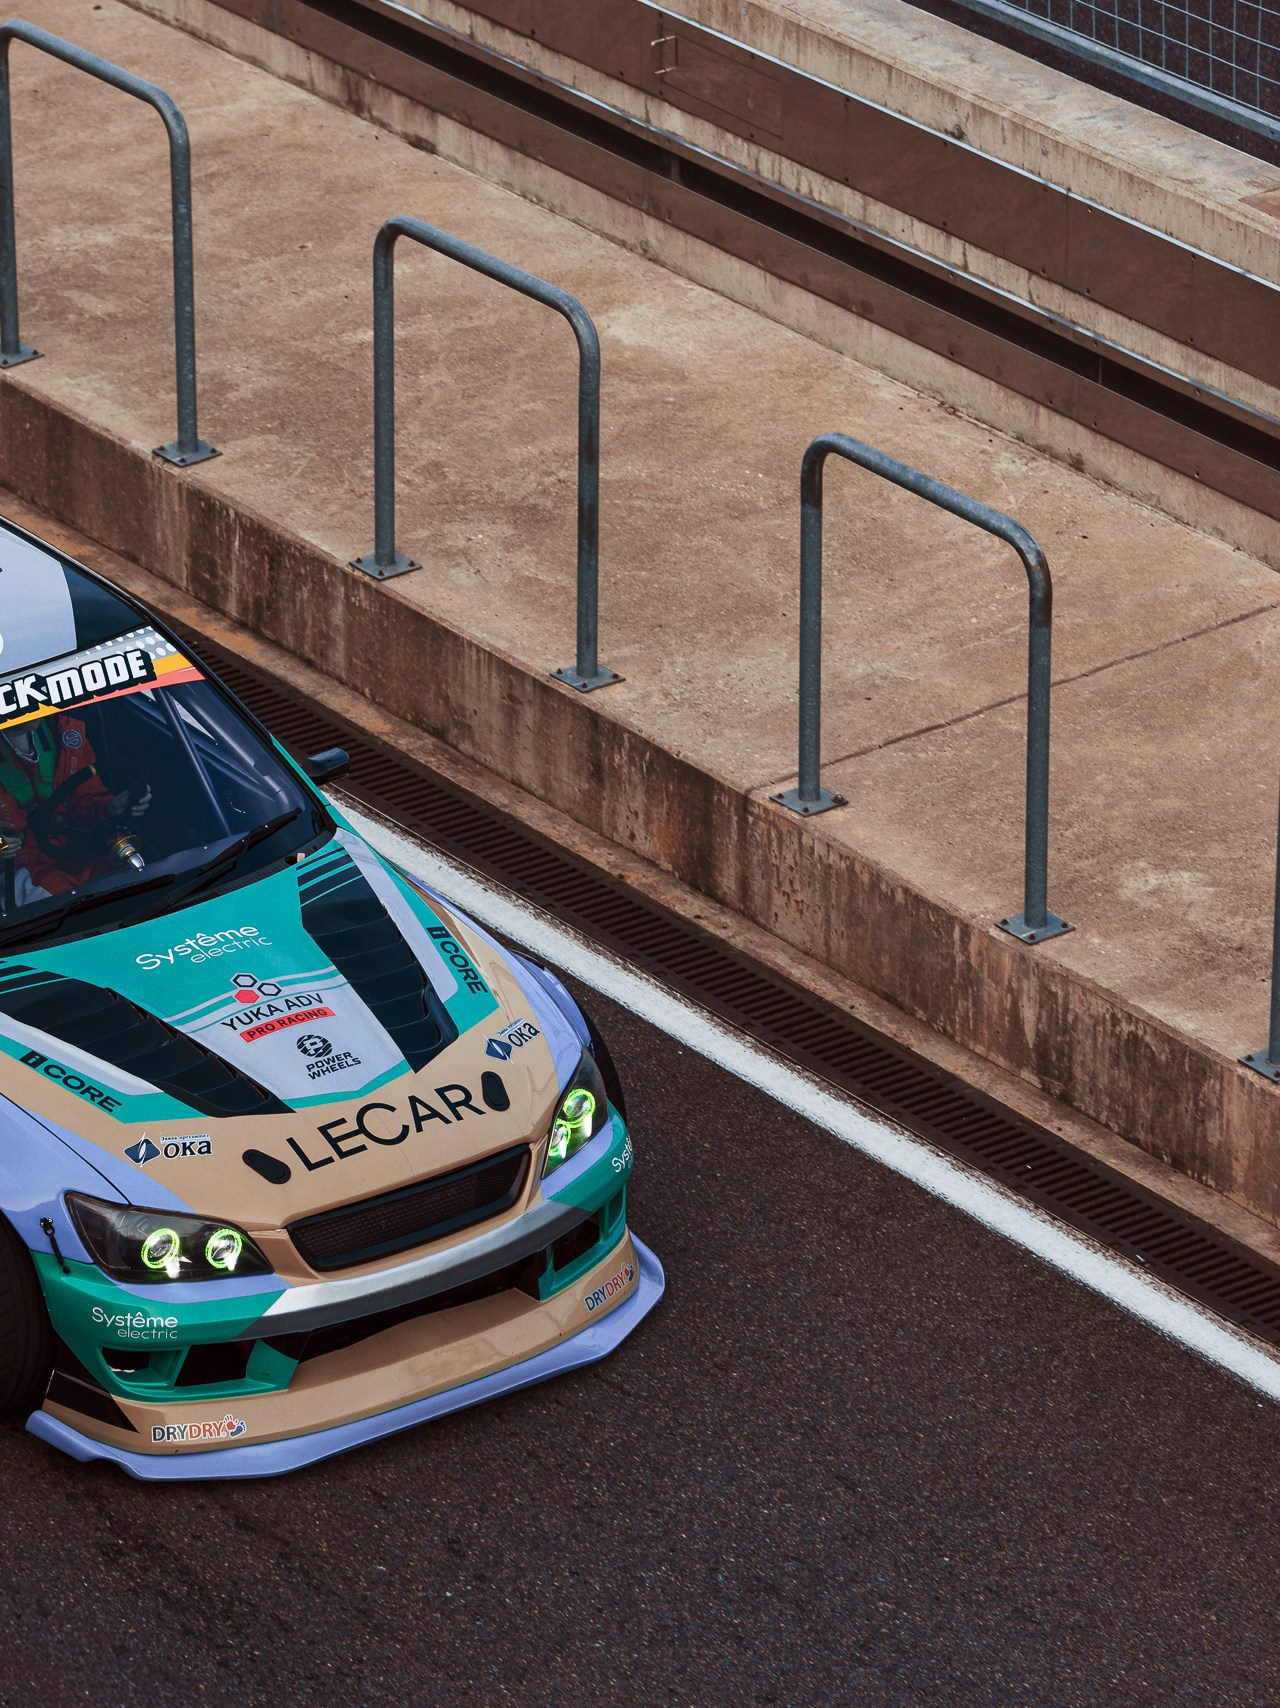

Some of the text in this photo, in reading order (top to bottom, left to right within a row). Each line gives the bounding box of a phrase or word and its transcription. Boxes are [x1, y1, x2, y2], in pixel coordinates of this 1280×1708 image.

[136, 926, 259, 970] Systême
[191, 937, 272, 963] electric
[220, 993, 325, 1031] YUKA ADV
[247, 1009, 328, 1039] PRO RACING
[305, 1051, 353, 1072] POWER
[307, 1057, 362, 1080] WHEELS
[285, 1083, 486, 1171] LECAR
[584, 1274, 626, 1312] DRYDRY
[92, 1307, 178, 1328] Systême
[117, 1327, 178, 1340] electric
[152, 1421, 224, 1442] DRYDRY
